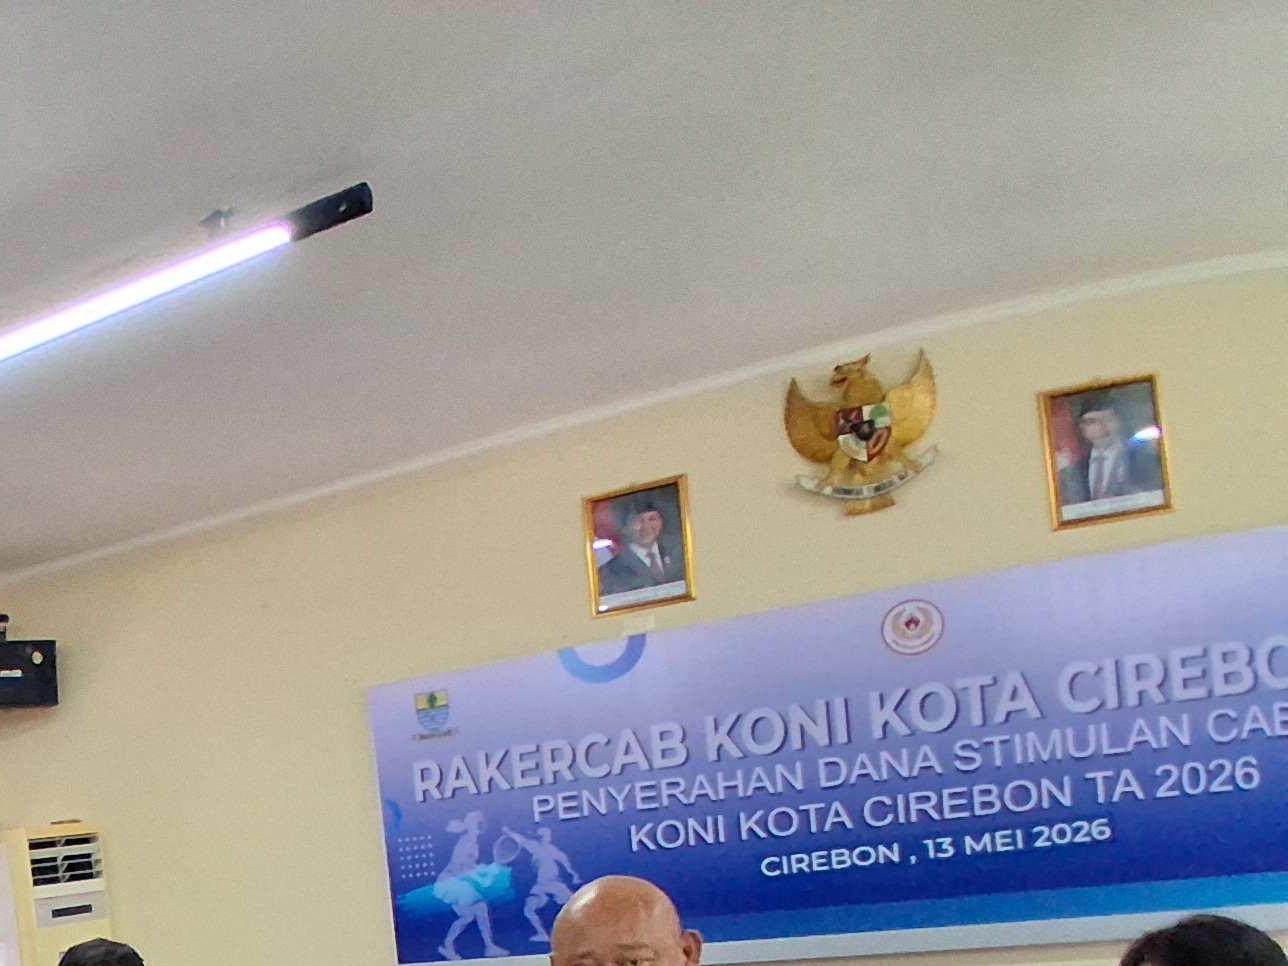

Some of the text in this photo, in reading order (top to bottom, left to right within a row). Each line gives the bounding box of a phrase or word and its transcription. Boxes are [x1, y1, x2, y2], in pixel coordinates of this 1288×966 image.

[413, 721, 689, 802] RAKERCAB
[705, 696, 852, 762] KONI
[869, 671, 1044, 740] KOTA
[533, 760, 804, 822] PENYERAHAN
[818, 745, 943, 788] DANA
[953, 713, 1191, 772] STIMULAN
[630, 755, 1261, 852] KONI KOTA CIREBON TA 2026
[761, 842, 900, 877] CIREBON
[922, 836, 955, 859] 13
[964, 829, 1024, 856] MEI
[1032, 817, 1112, 848] 2026
